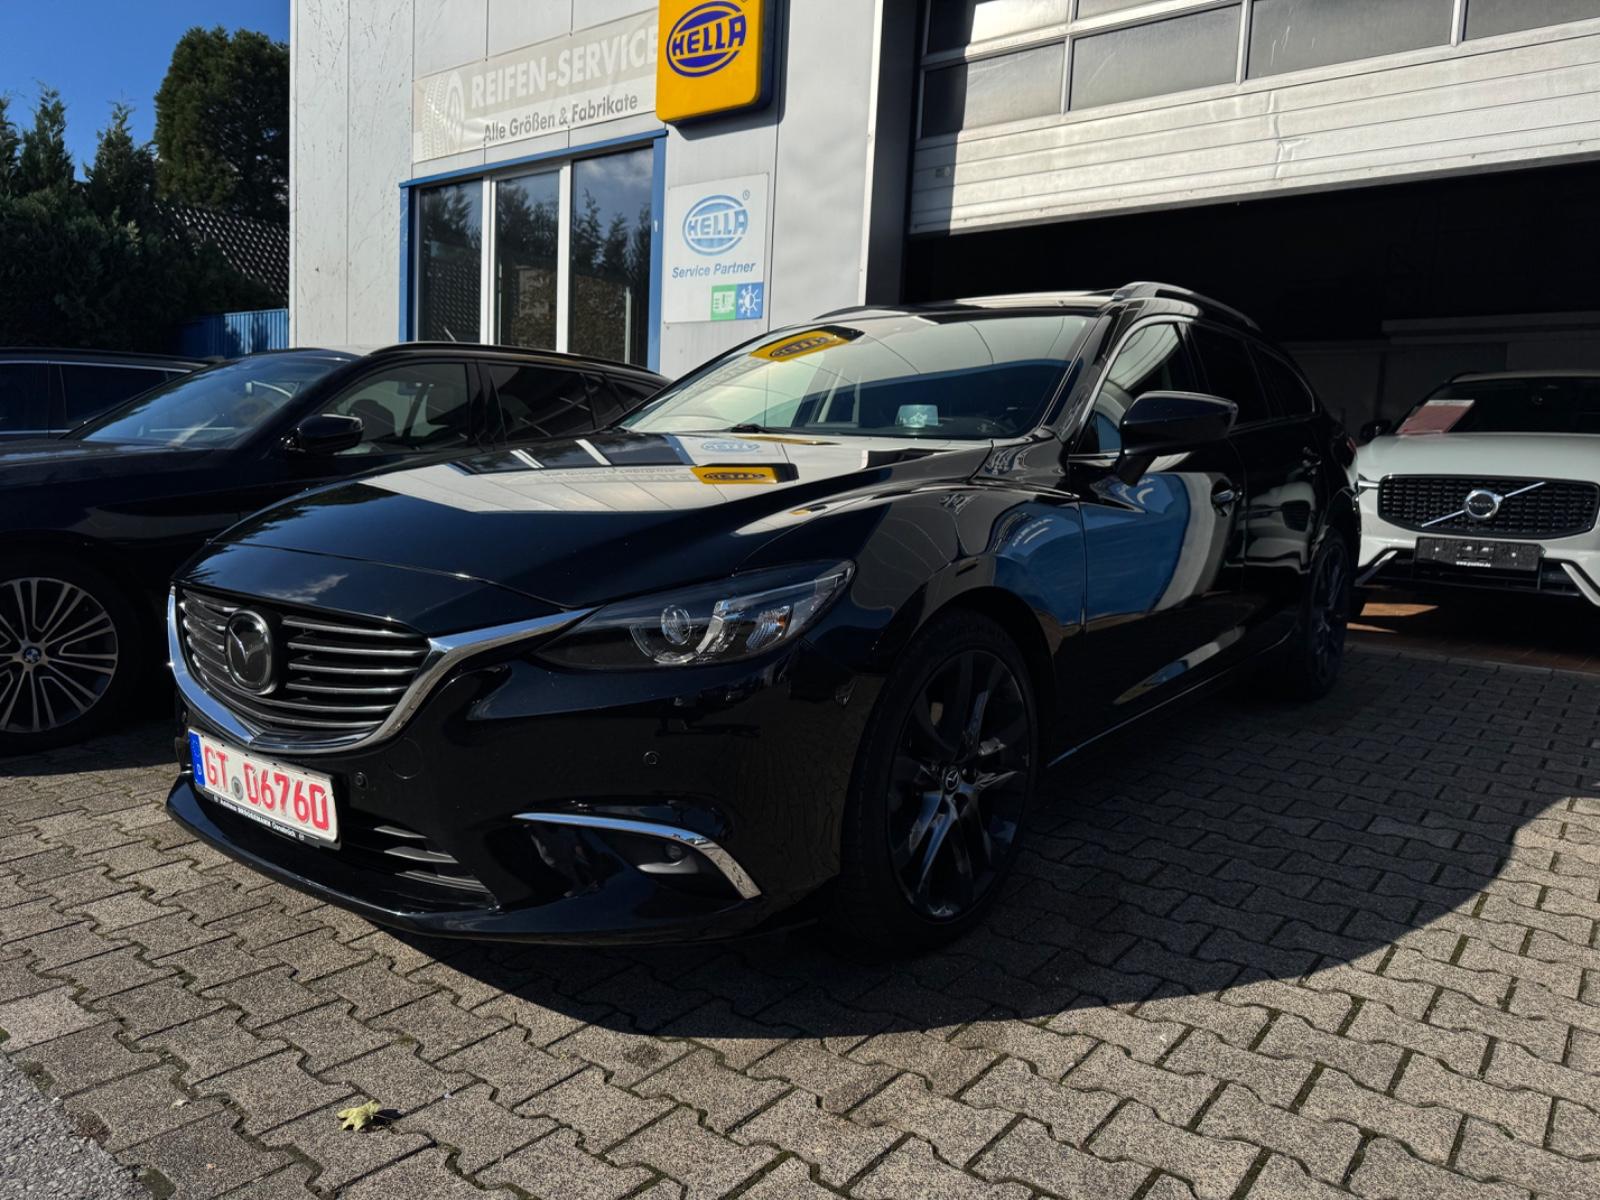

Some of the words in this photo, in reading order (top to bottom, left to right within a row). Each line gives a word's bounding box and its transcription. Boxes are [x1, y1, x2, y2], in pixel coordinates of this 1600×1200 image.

[671, 14, 747, 57] HELLA
[471, 25, 658, 109] REIFEN-SERVICE
[484, 124, 506, 142] Alle
[509, 112, 556, 137] Größen
[558, 106, 569, 126] &
[571, 95, 639, 123] Fabrikate
[687, 208, 749, 237] HELLA
[672, 265, 711, 279] Service
[713, 262, 757, 276] Partner
[204, 745, 229, 792] GT
